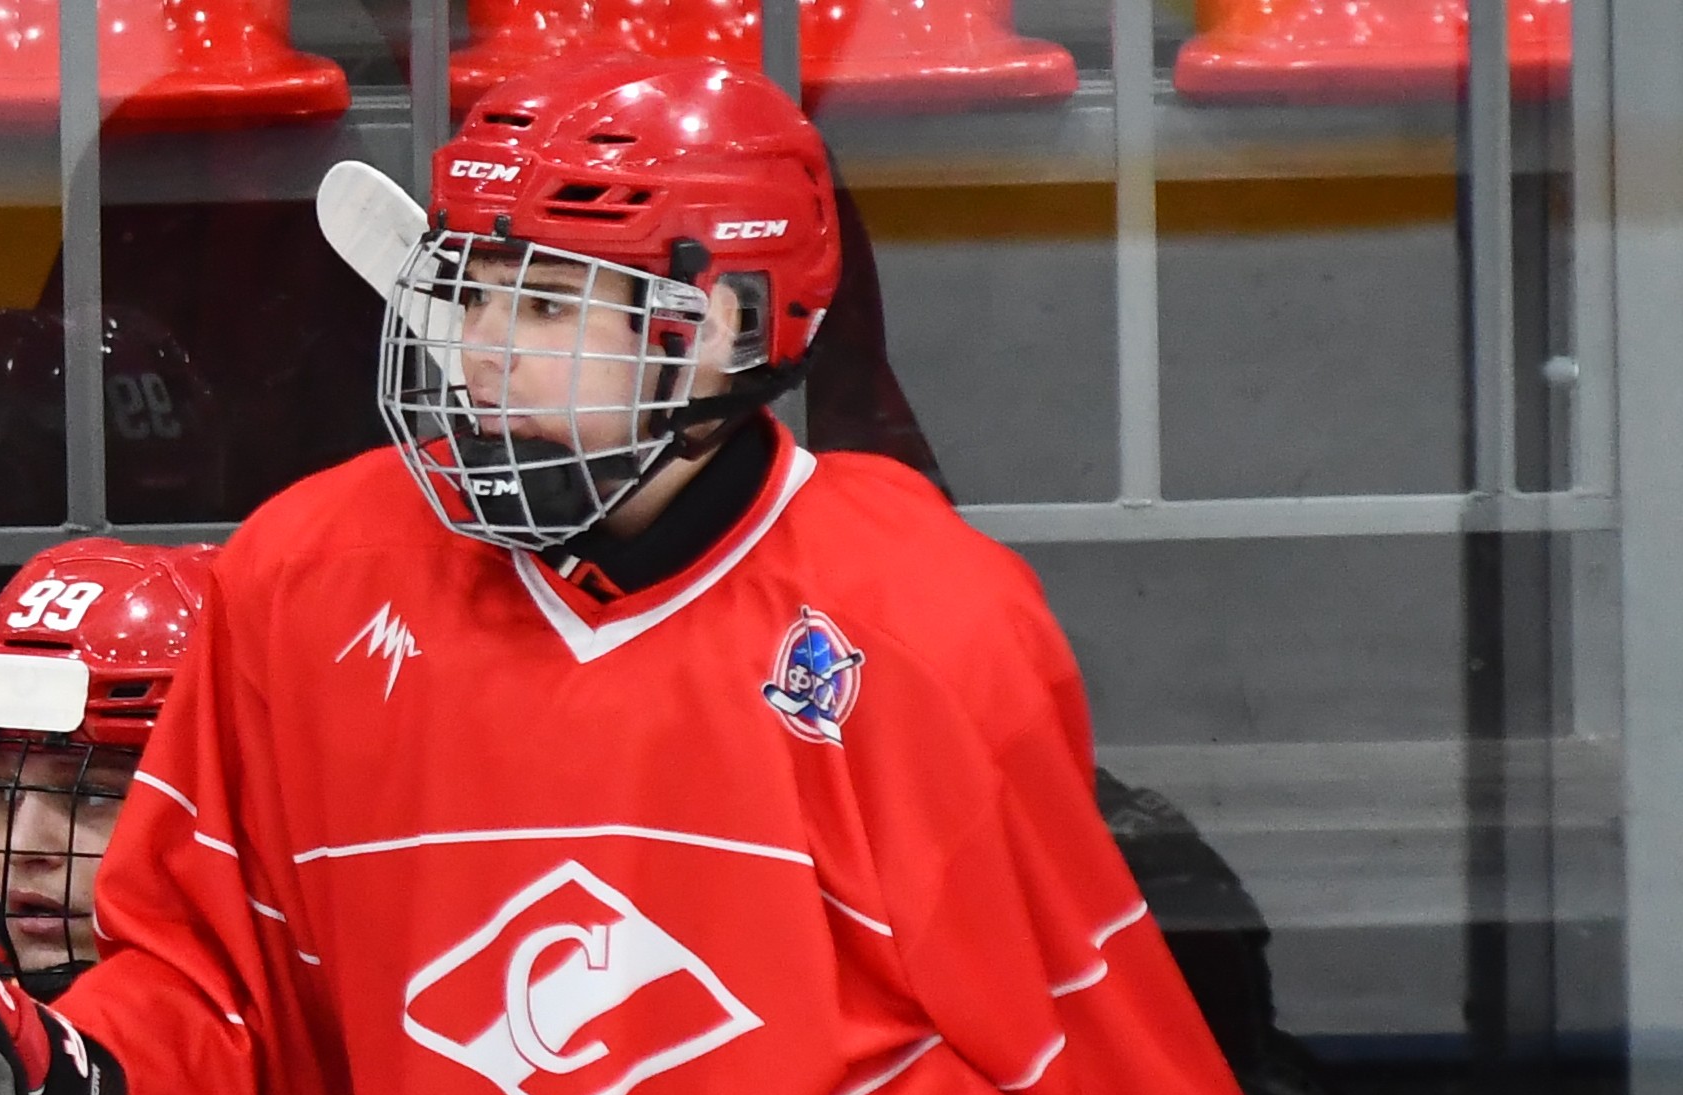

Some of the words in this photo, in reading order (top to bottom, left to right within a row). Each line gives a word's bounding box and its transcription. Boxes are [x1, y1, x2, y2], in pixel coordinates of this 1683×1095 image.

[449, 159, 521, 182] CCM
[714, 219, 789, 240] CCM
[470, 478, 520, 496] CM
[6, 579, 104, 632] 99
